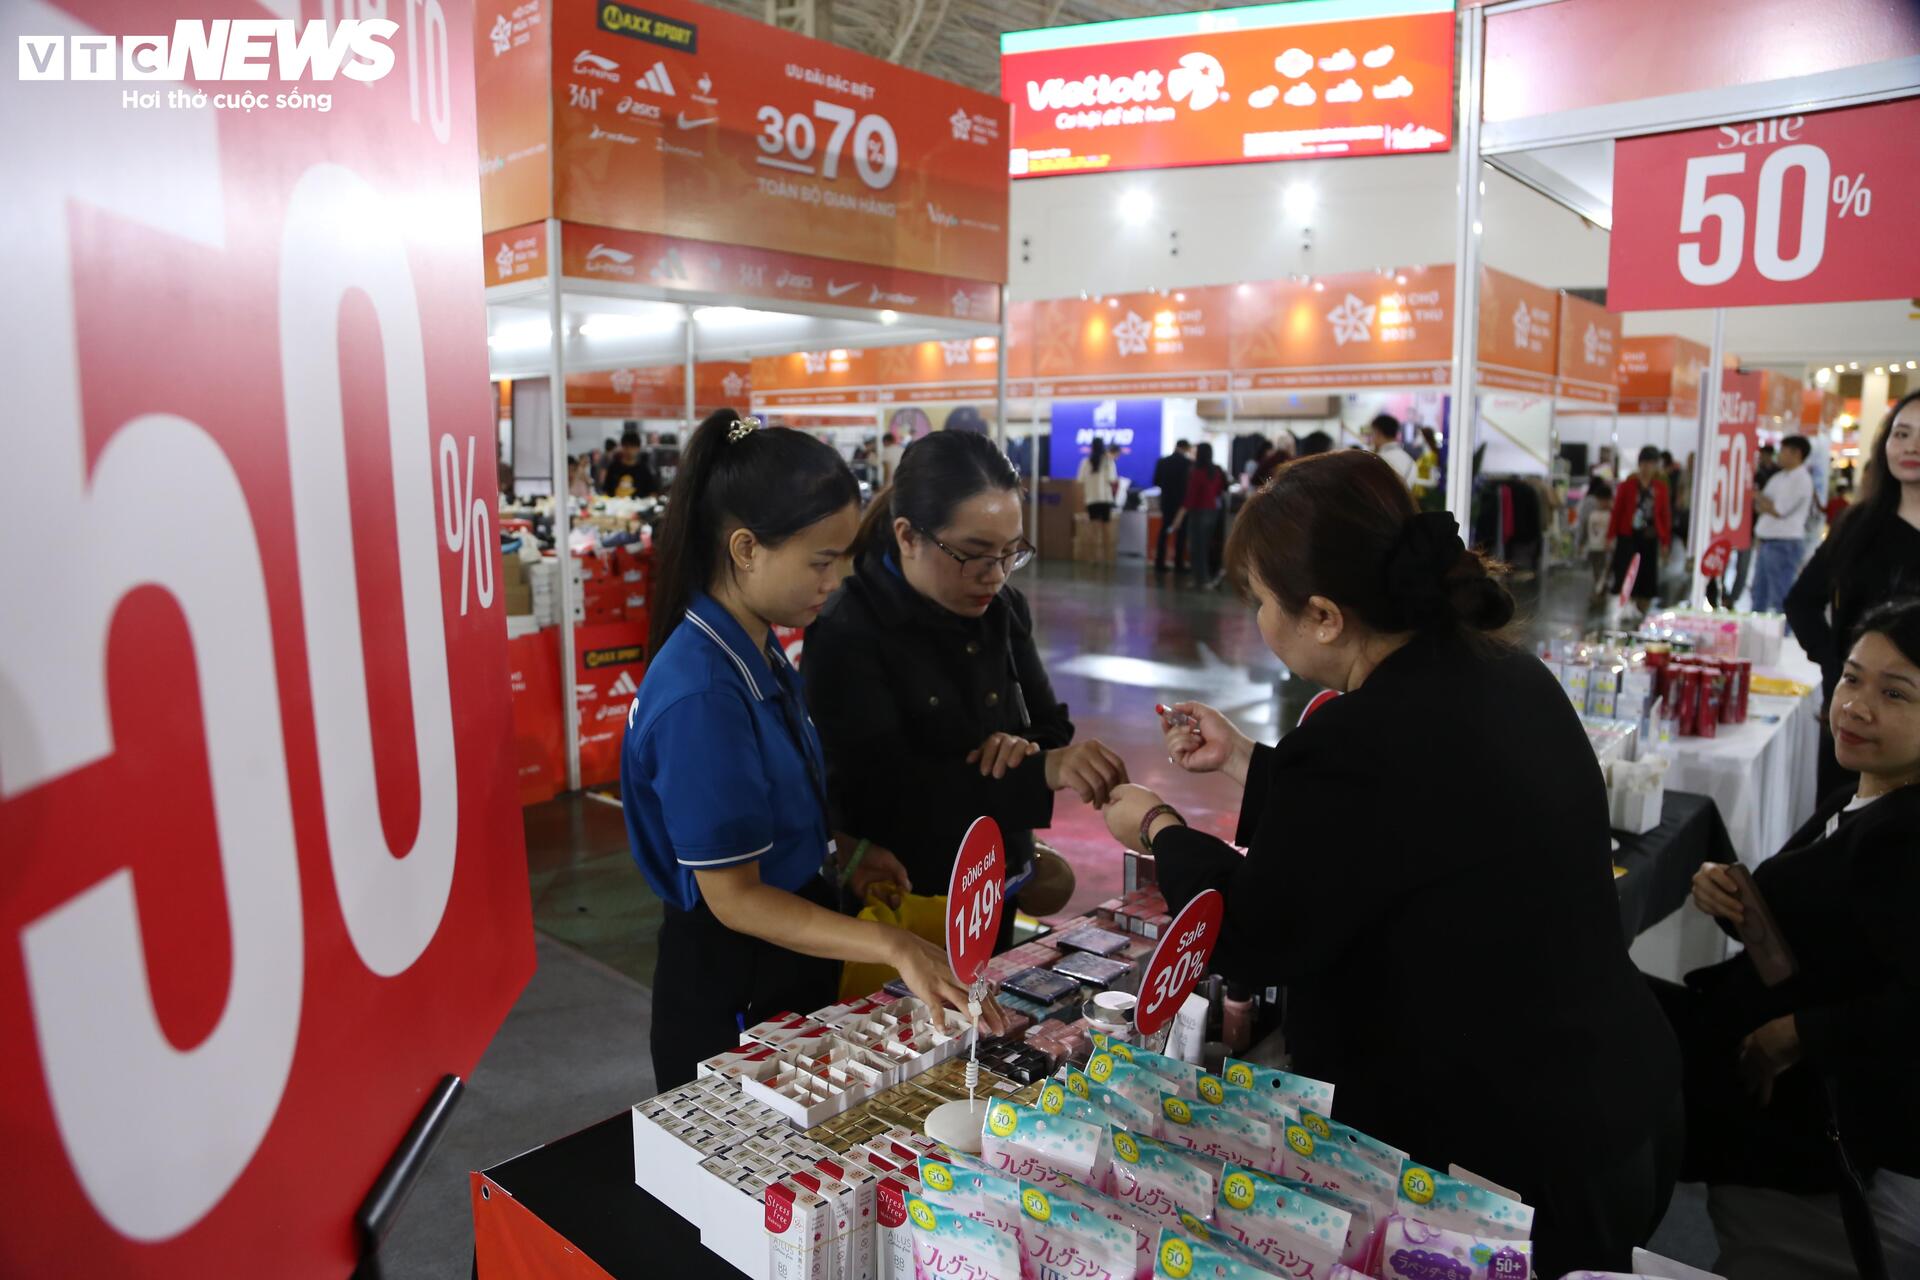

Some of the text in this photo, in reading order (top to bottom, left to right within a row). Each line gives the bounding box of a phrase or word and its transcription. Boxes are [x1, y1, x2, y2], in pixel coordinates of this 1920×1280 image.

[654, 20, 692, 45] SPORT
[962, 845, 996, 892] ĐỒNG GIÁ
[955, 879, 1002, 957] 149K
[1177, 920, 1206, 953] Sale
[1147, 948, 1206, 1014] 30%
[766, 1195, 790, 1216] Stress
[879, 1191, 905, 1211] Stress
[1495, 1257, 1521, 1273] 50+
